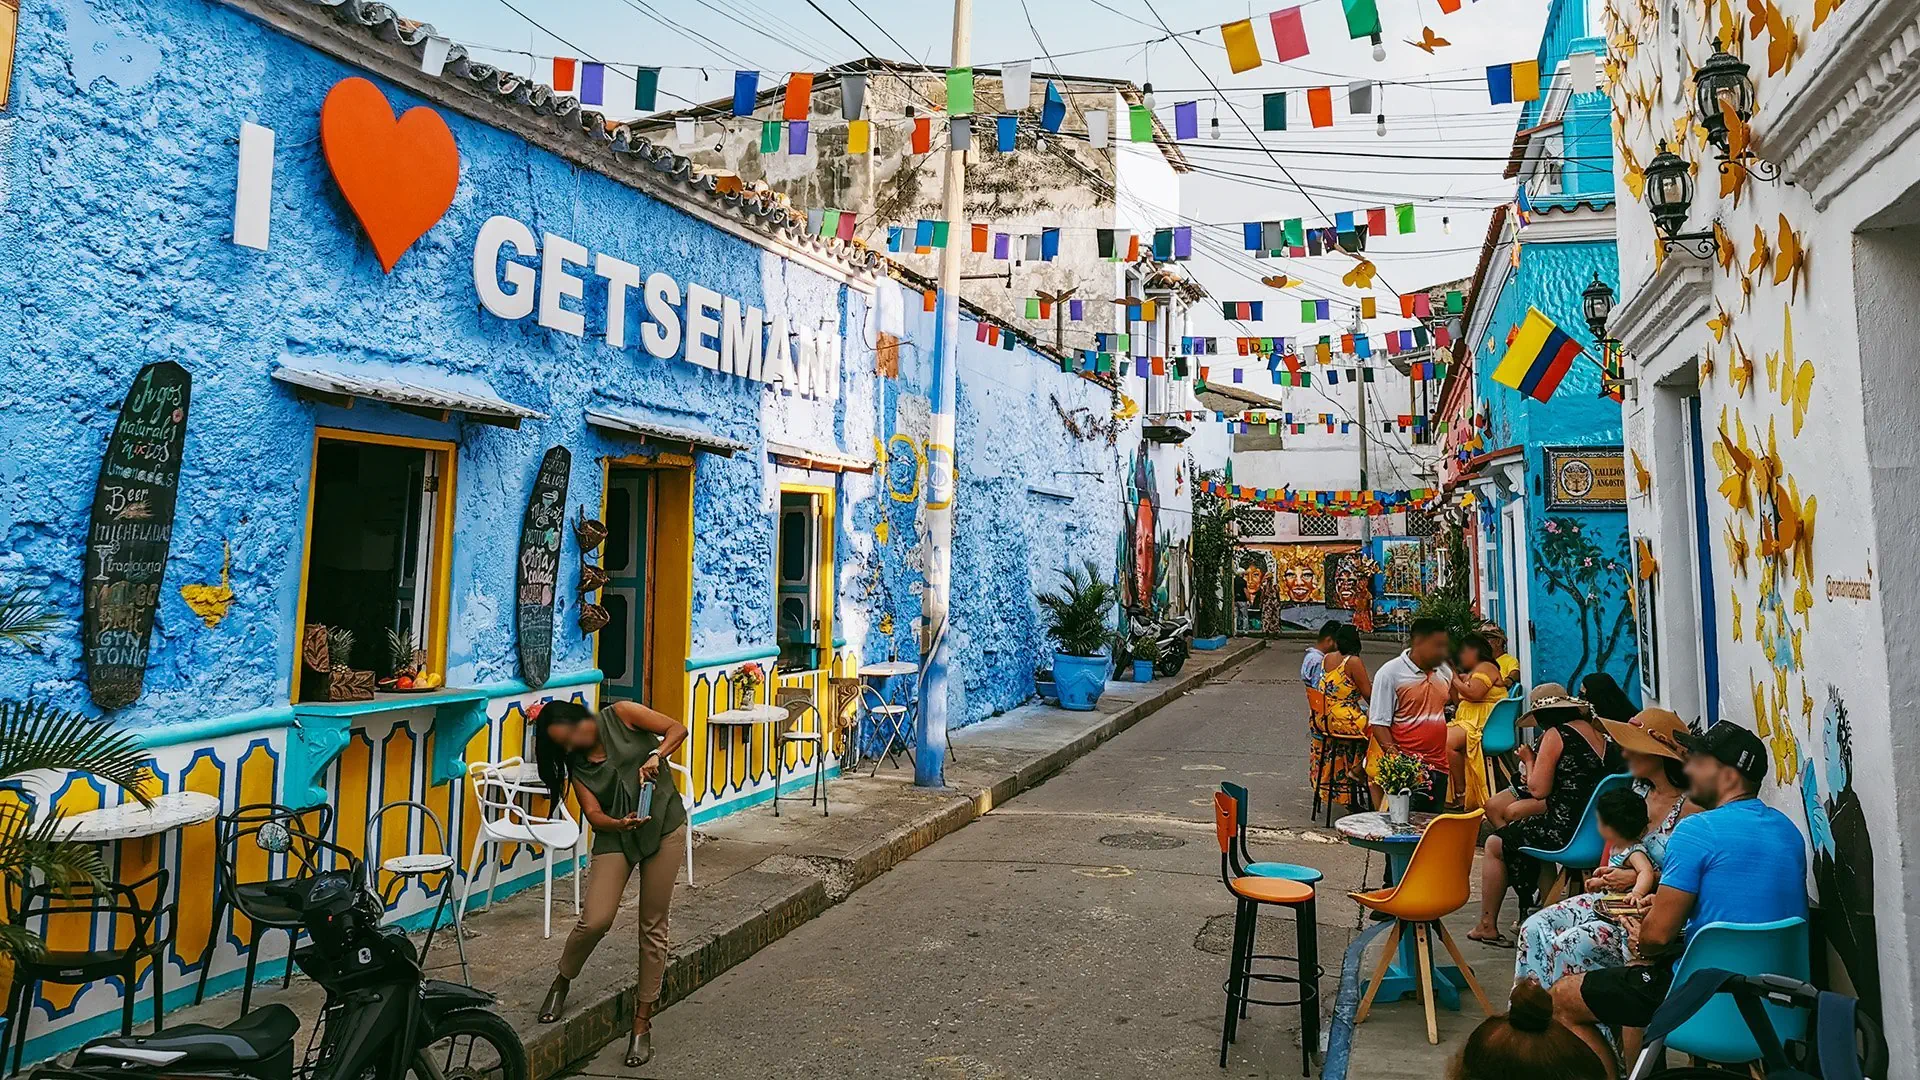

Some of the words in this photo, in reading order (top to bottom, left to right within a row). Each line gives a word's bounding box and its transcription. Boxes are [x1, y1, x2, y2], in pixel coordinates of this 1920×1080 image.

[233, 121, 275, 251] I
[473, 215, 841, 401] GETSEMANI
[132, 366, 182, 425] Jugos
[104, 485, 149, 515] Beer
